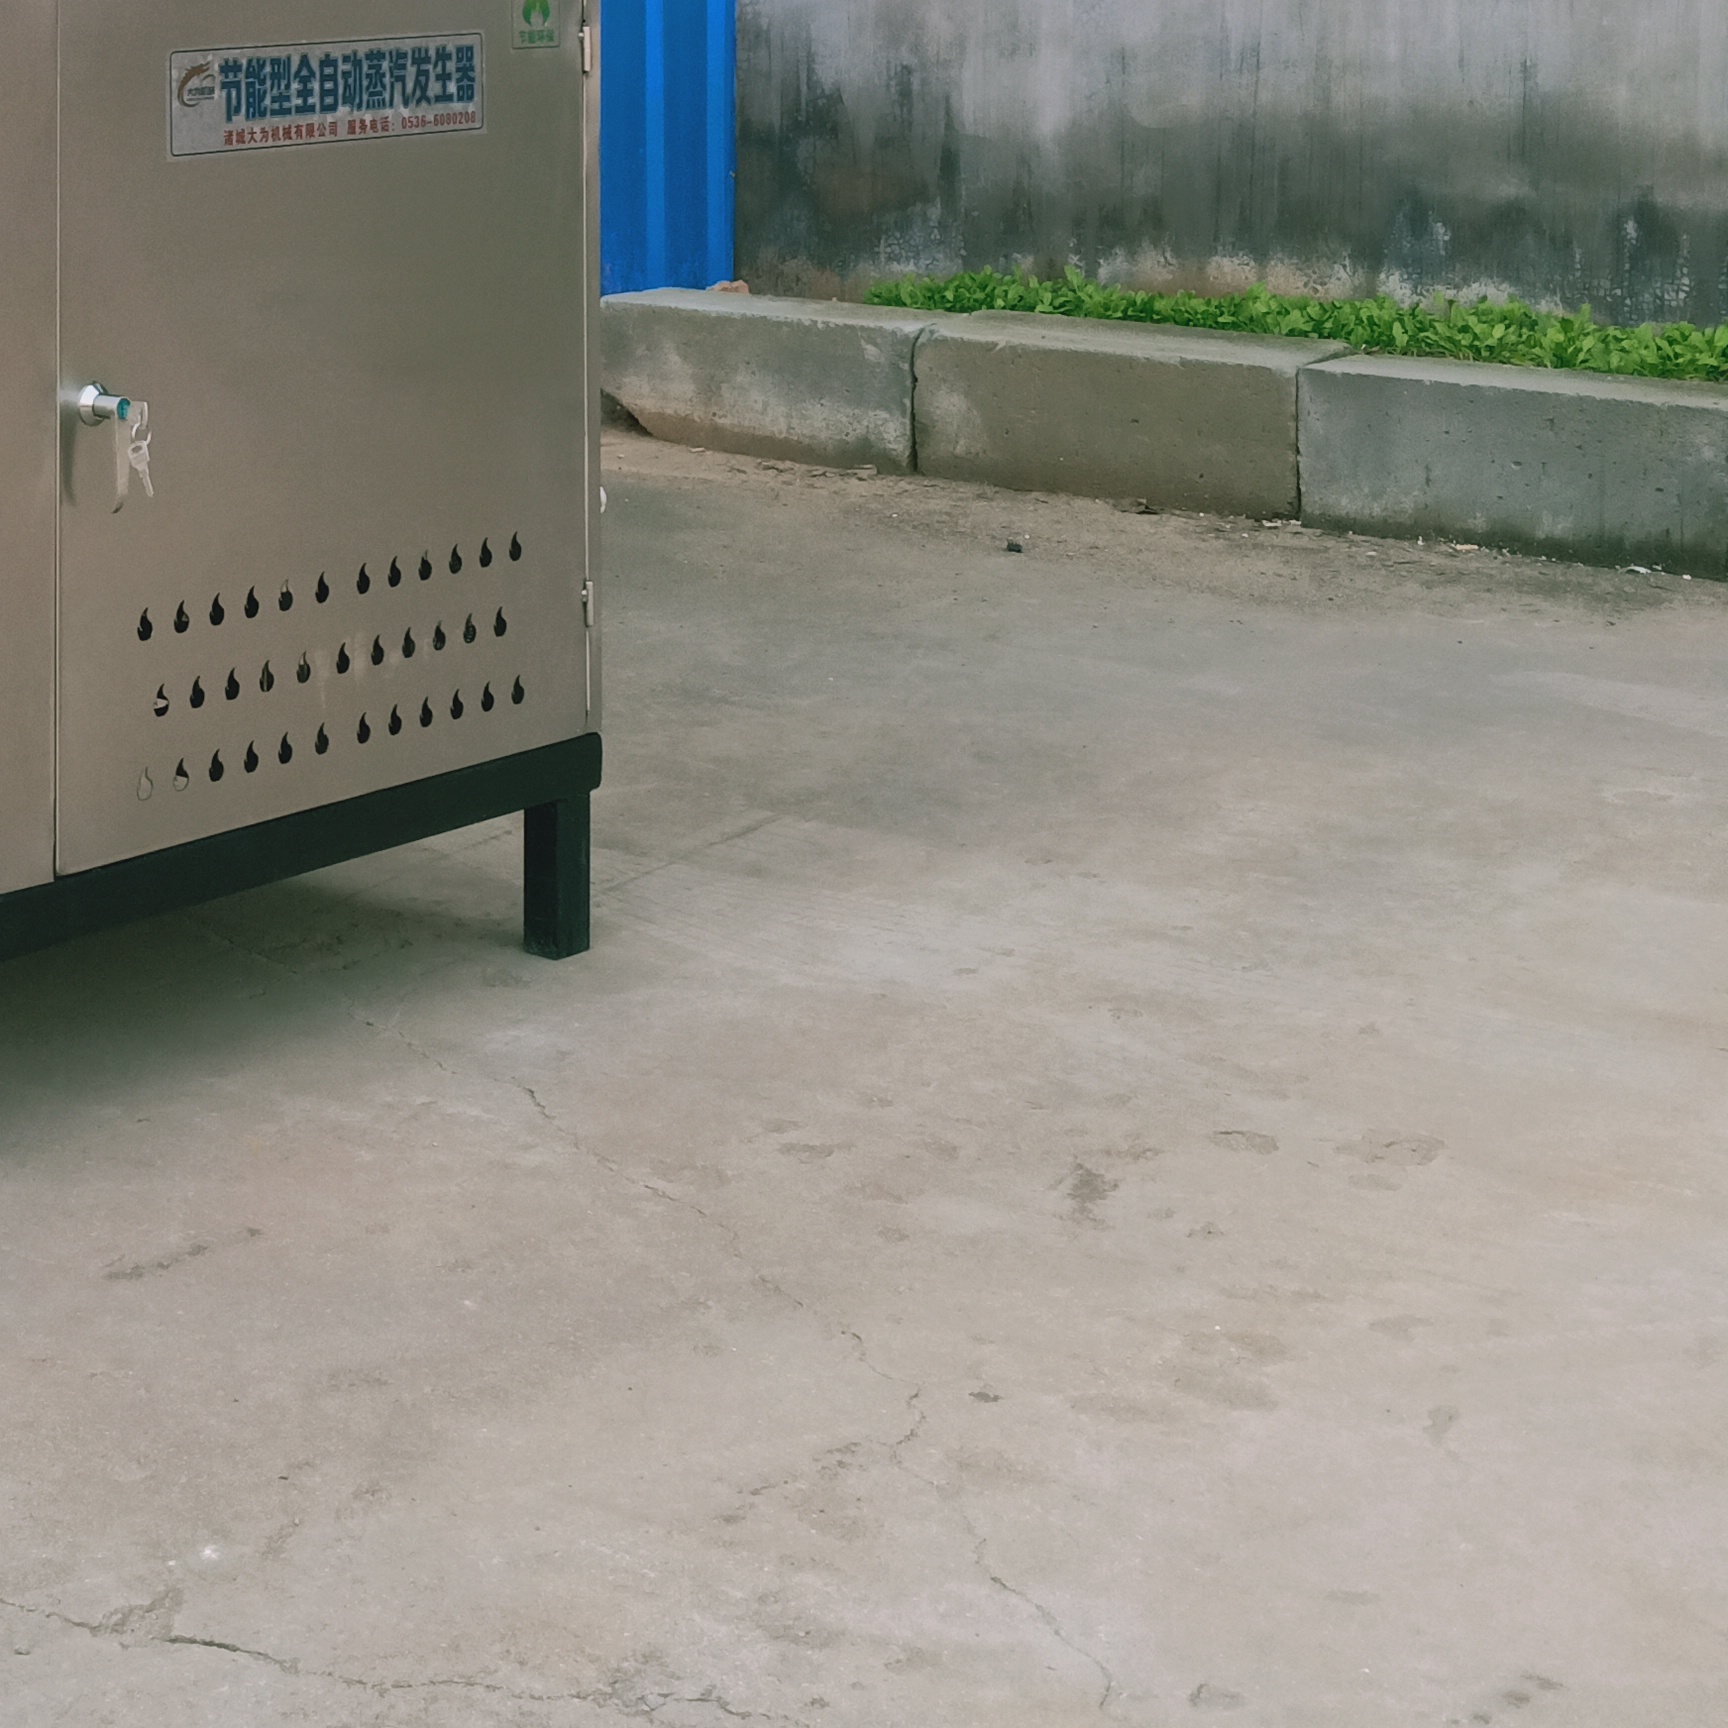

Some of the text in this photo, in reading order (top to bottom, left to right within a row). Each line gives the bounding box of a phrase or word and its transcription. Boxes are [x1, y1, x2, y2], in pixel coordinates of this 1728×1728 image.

[219, 44, 477, 123] 节能型全自动蒸汽发生器
[223, 121, 339, 146] 诸城大为机械有限公司
